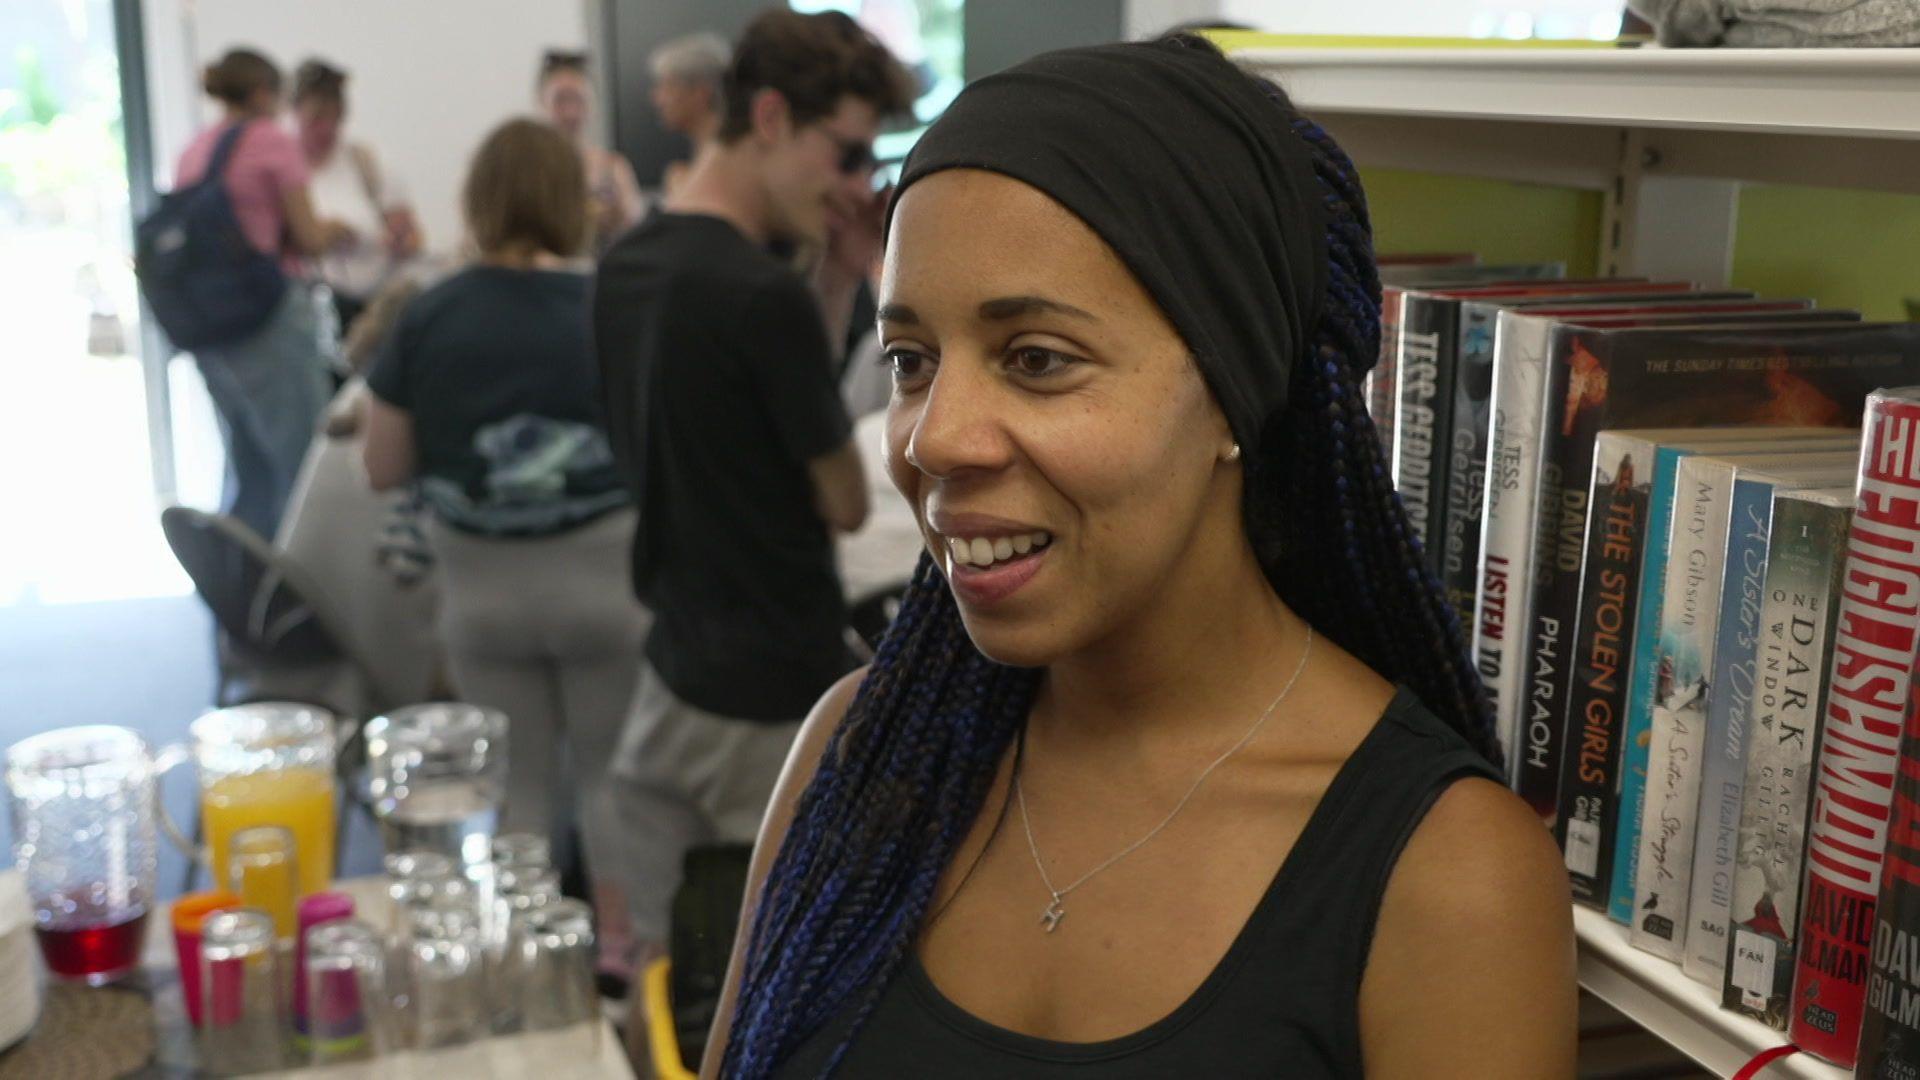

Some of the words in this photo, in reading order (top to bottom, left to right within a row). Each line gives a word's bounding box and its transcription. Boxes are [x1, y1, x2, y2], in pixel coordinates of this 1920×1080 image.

[1645, 359, 1669, 373] THE
[1672, 358, 1723, 373] SUNDAY
[1446, 428, 1476, 573] Gerritsen
[1504, 445, 1522, 490] TESS
[1557, 489, 1587, 573] DAVID
[1602, 501, 1636, 563] THE
[1688, 481, 1714, 538] Mary
[1745, 503, 1769, 543] A
[1480, 553, 1510, 641] LISTEN
[1681, 549, 1708, 627] Gibson
[1479, 648, 1503, 679] TO
[1588, 569, 1627, 693] STOLEN
[1527, 615, 1560, 769] PHARAOH
[1761, 621, 1785, 732] WINDOW
[1779, 613, 1817, 751] DARK
[1579, 699, 1613, 784] GIRLS
[1670, 718, 1690, 734] A
[1715, 782, 1740, 867] Elizabeth
[1773, 767, 1794, 868] RACHEL
[1710, 871, 1729, 908] Gill
[1808, 882, 1876, 947] AVID
[1738, 947, 1765, 964] FAN
